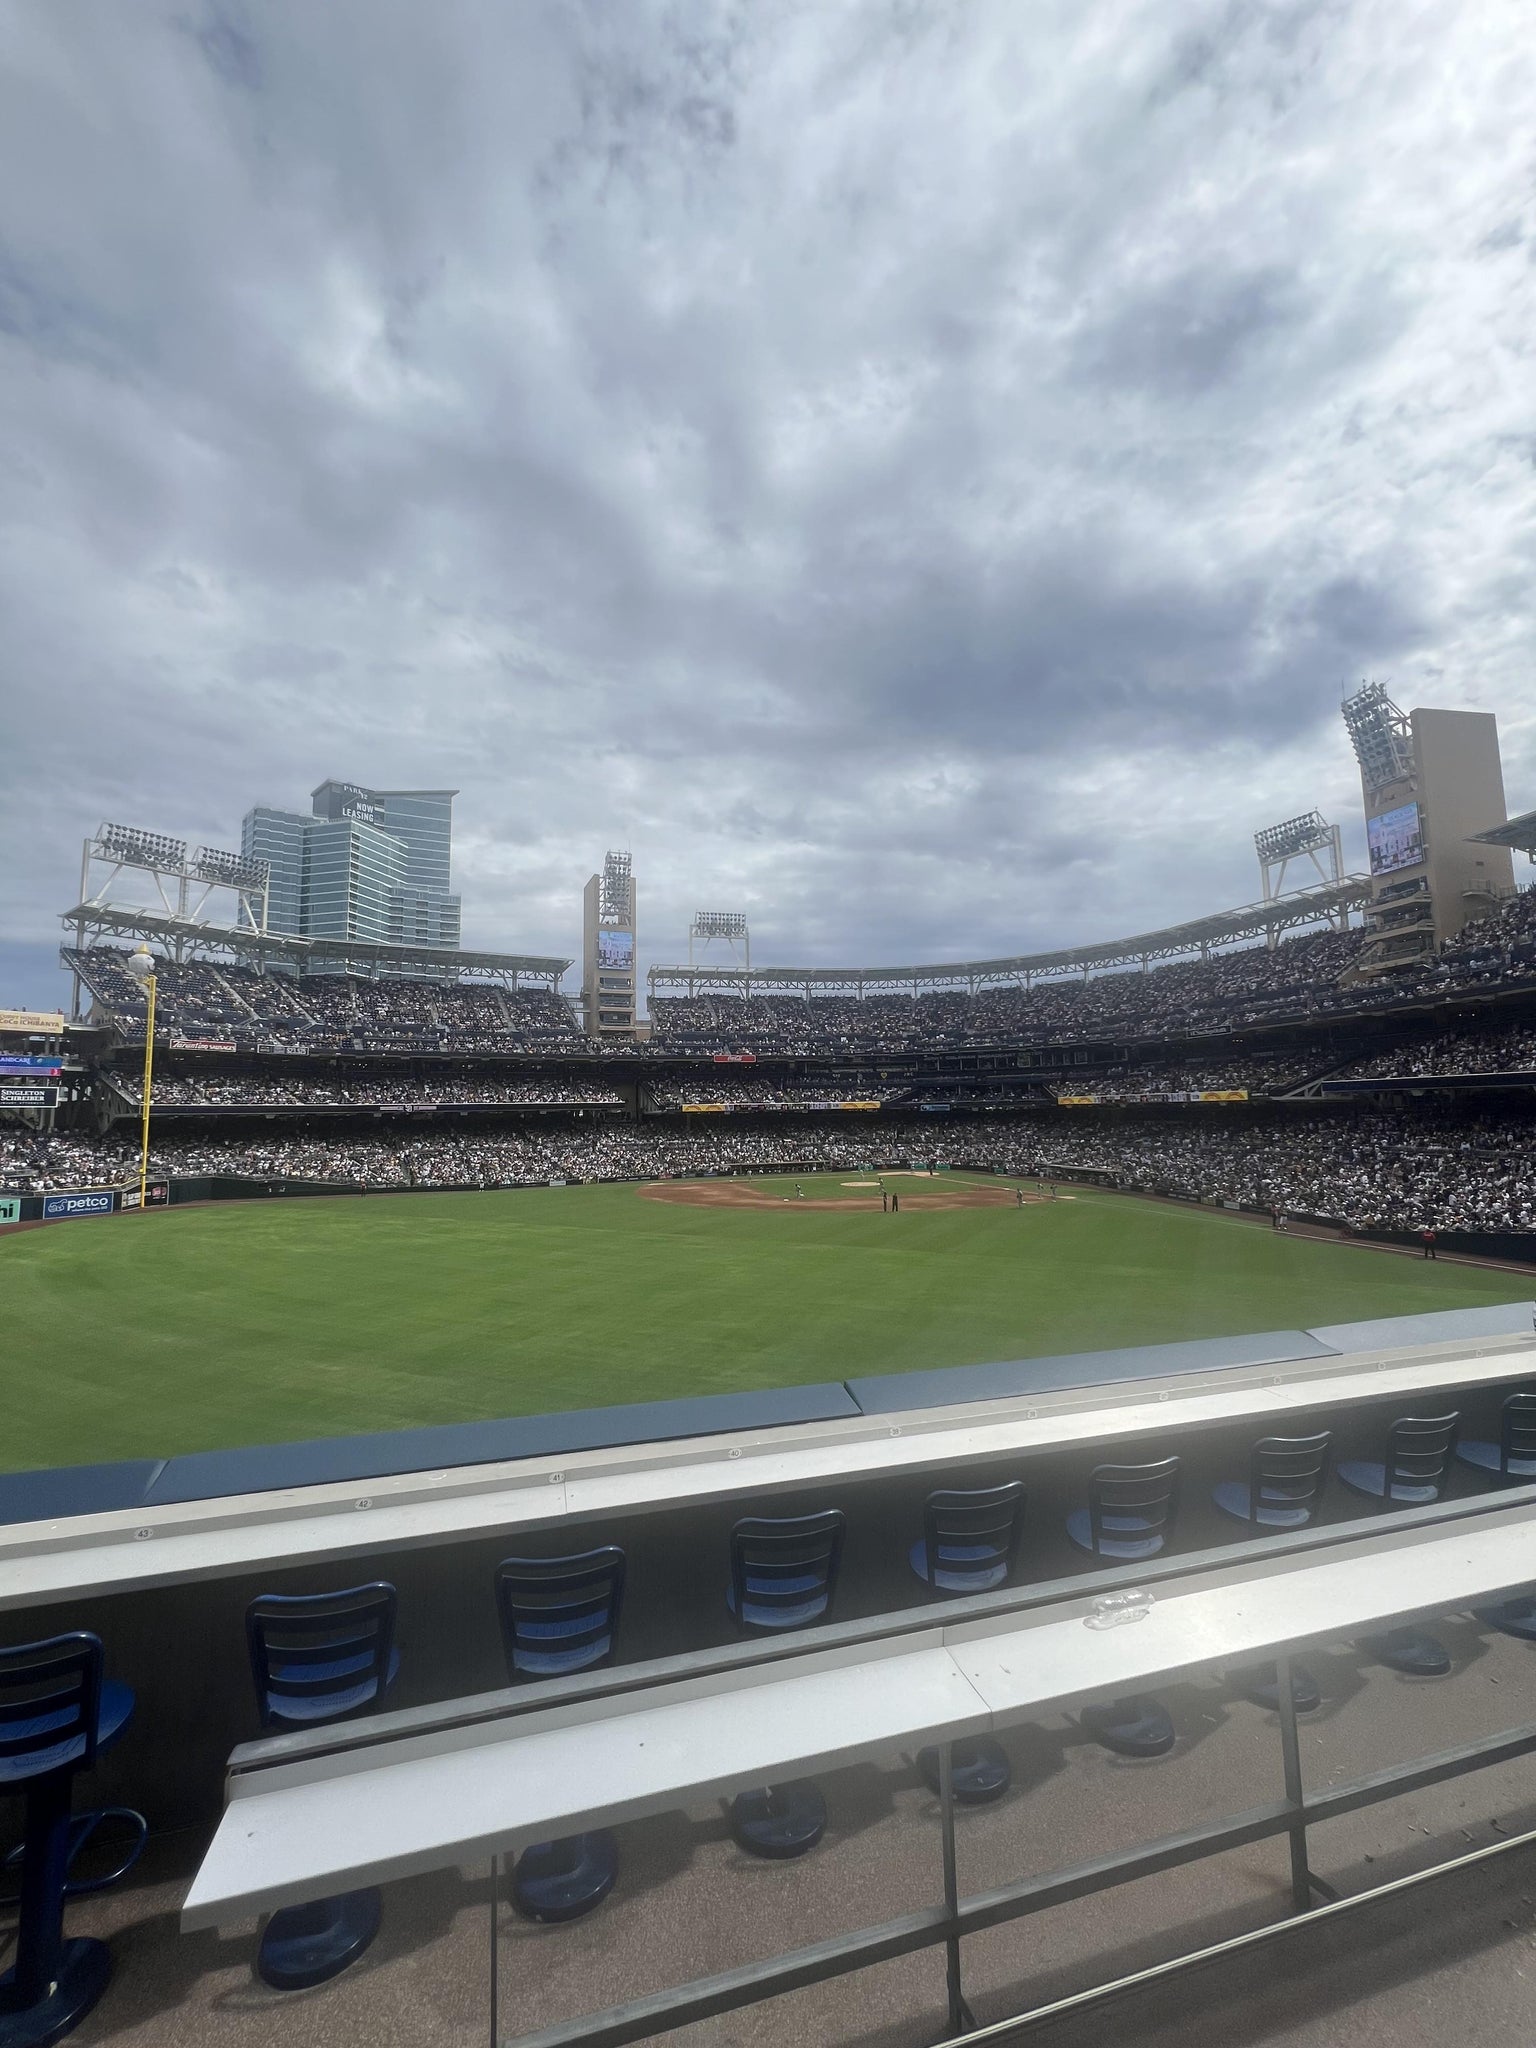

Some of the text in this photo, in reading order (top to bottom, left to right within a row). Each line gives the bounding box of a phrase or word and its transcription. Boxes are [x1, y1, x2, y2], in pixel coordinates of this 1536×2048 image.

[356, 802, 374, 813] NOW
[342, 807, 374, 822] LEASING
[67, 1197, 108, 1211] petco
[358, 1500, 368, 1508] 42
[137, 1529, 148, 1538] 43
